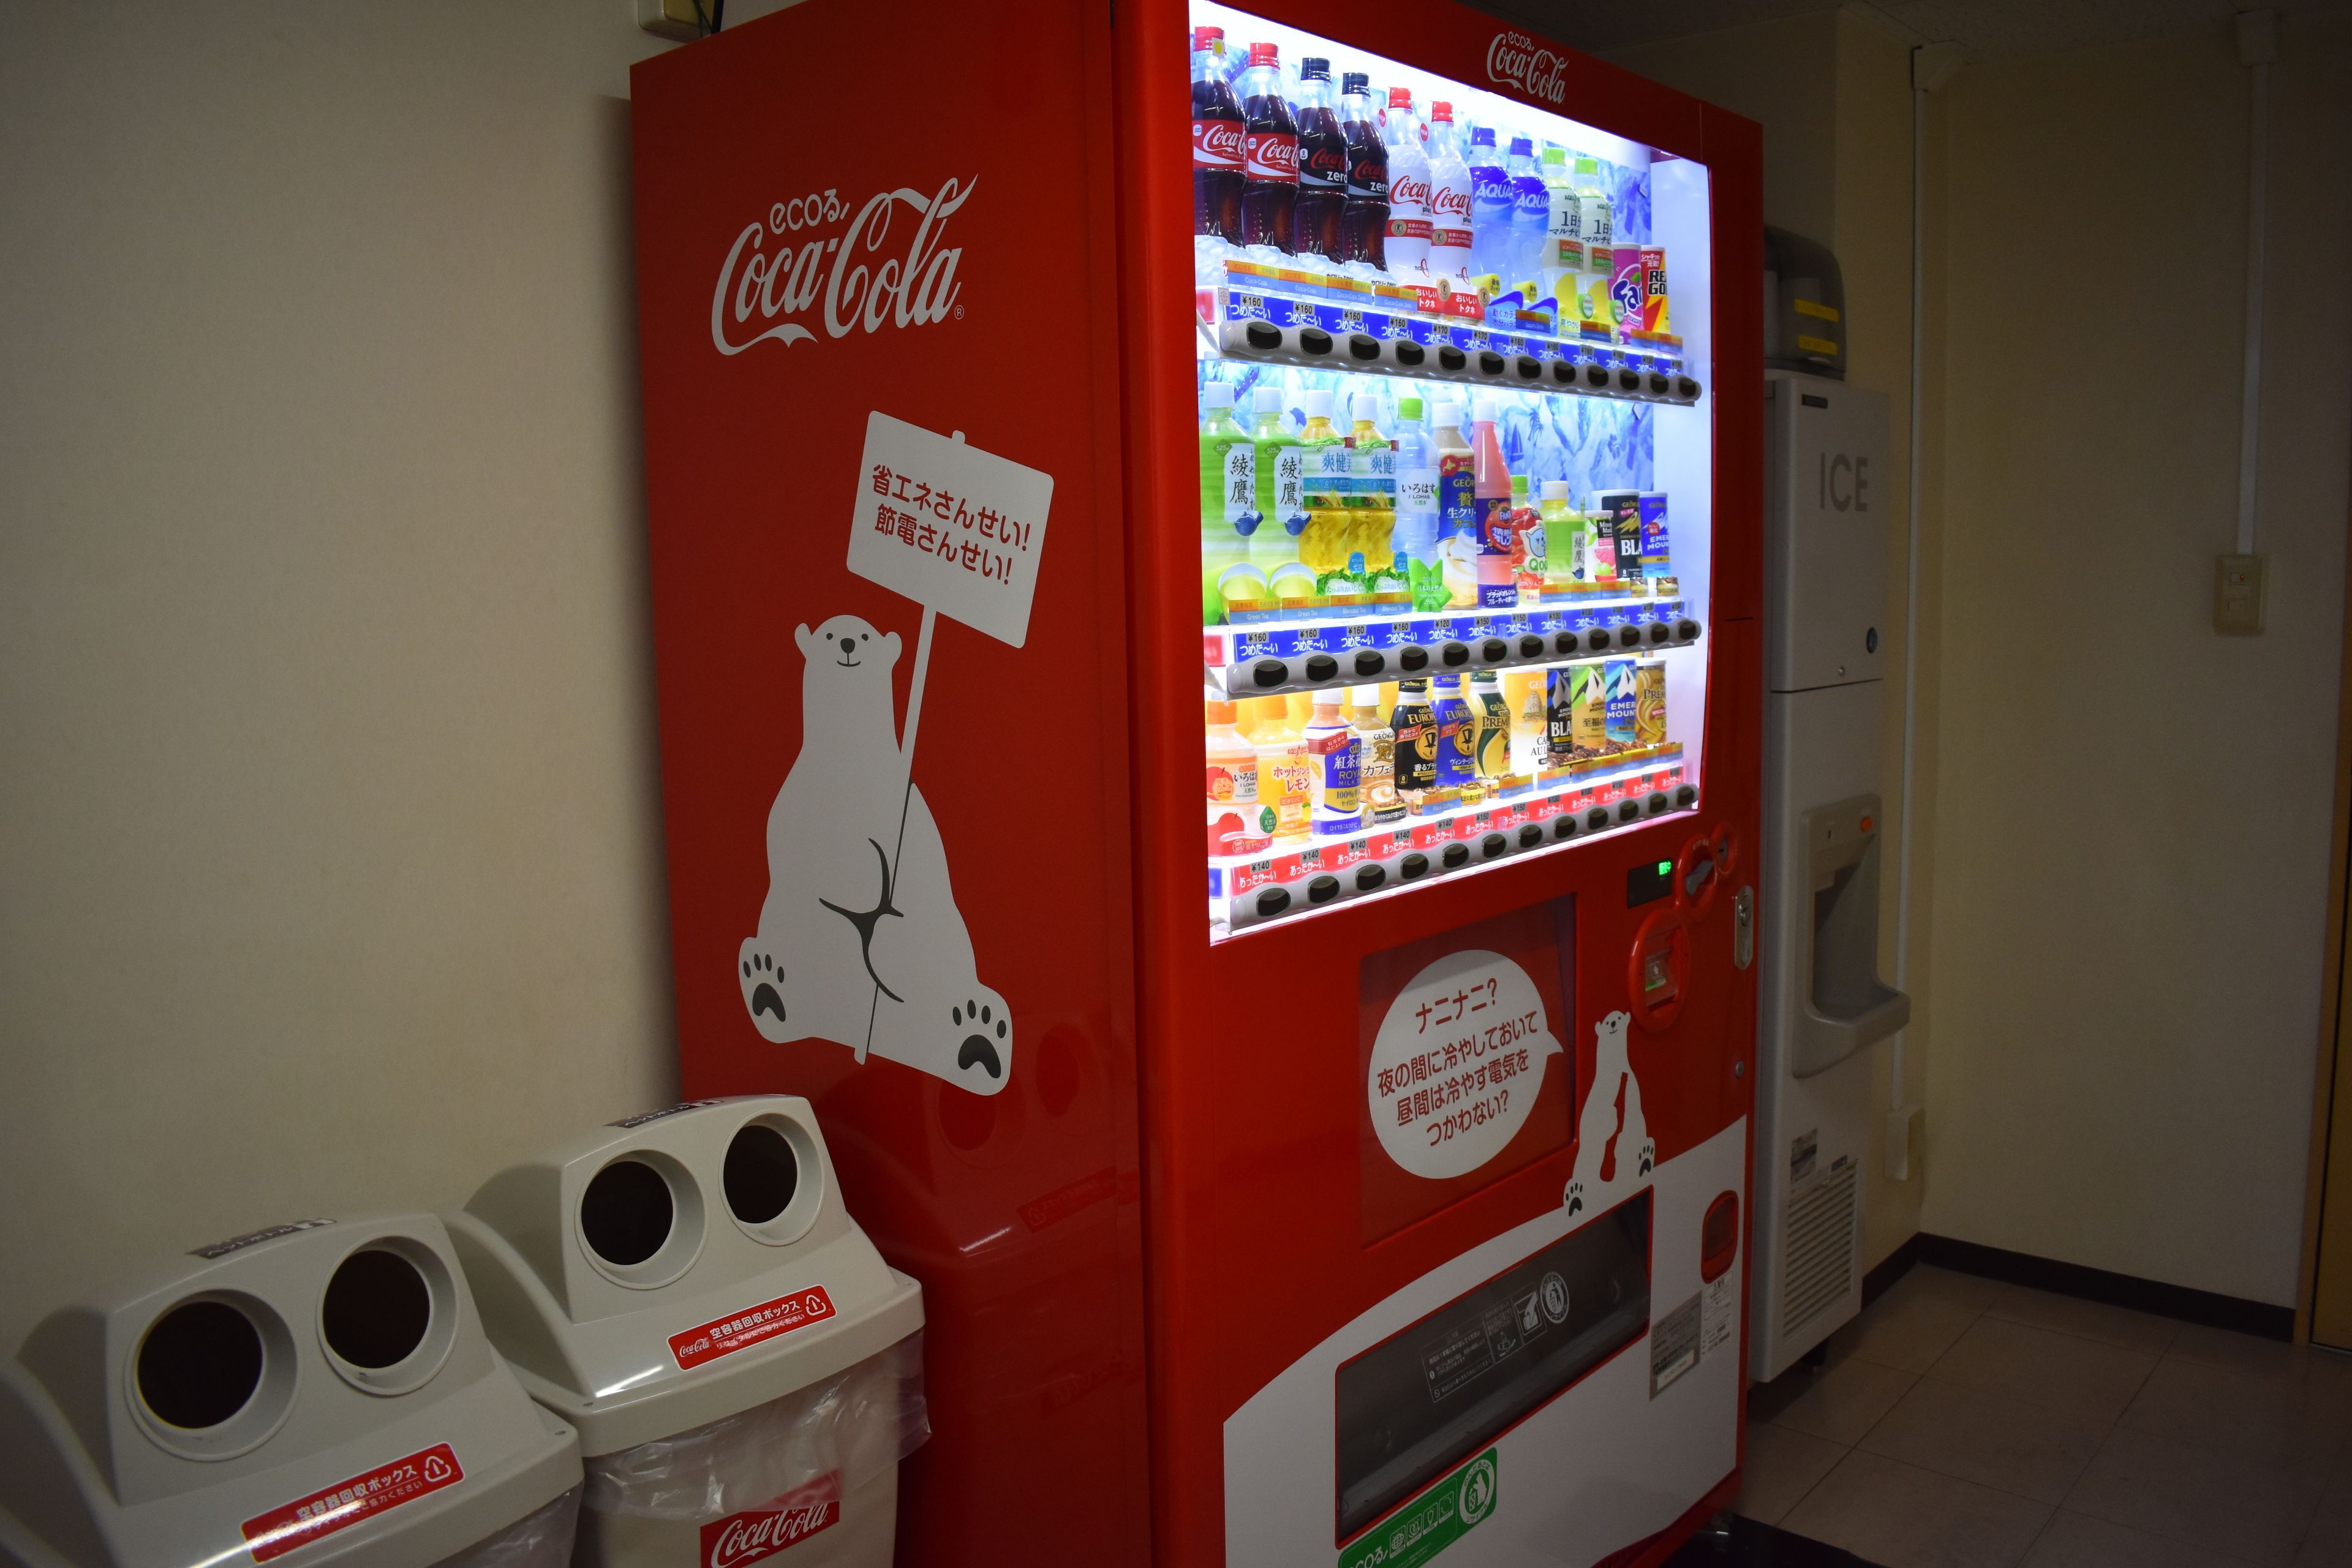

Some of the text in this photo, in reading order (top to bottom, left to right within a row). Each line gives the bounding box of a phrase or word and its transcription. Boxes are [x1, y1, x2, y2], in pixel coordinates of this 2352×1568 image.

[1487, 33, 1569, 104] Coca-Cola
[712, 173, 979, 356] Coca-Cola
[1648, 283, 1667, 295] GO
[1242, 296, 1261, 307] ¥160
[1456, 295, 1477, 305] おいしい
[1295, 304, 1313, 314] ¥160
[1459, 305, 1476, 314] トクホ
[1344, 311, 1361, 321] ¥160
[1390, 318, 1406, 328] ¥160
[1433, 325, 1448, 334] ¥170
[1229, 454, 1249, 505] 綾鷹
[1280, 456, 1298, 506] 綾鷹
[1819, 452, 1869, 512] ICE
[1401, 483, 1436, 494] いろはす
[872, 464, 1030, 551] 省エネさんせい!
[875, 503, 1012, 585] 節電さんせい!
[1393, 623, 1409, 631] ¥160
[1435, 619, 1450, 628] ¥120
[1300, 629, 1317, 638] ¥160
[1348, 626, 1364, 635] ¥160
[1248, 633, 1267, 643] ¥160
[1286, 778, 1310, 793] レモン
[1438, 819, 1452, 828] ¥140
[1395, 831, 1410, 840] ¥140
[1350, 840, 1366, 850] ¥140
[1303, 850, 1319, 860] ¥140
[1251, 861, 1270, 871] ¥140
[1415, 978, 1498, 1035] ナニナニ?
[1378, 1011, 1538, 1098] 夜の間に冷やしておいて
[1397, 1049, 1529, 1126] 昼間は冷やす電気を
[1427, 1089, 1509, 1147] つかわない?
[709, 1300, 800, 1340] 空容器回収ボックス
[679, 1337, 710, 1357] Coca-Cola
[295, 1464, 417, 1522] 空容器回収ボックス
